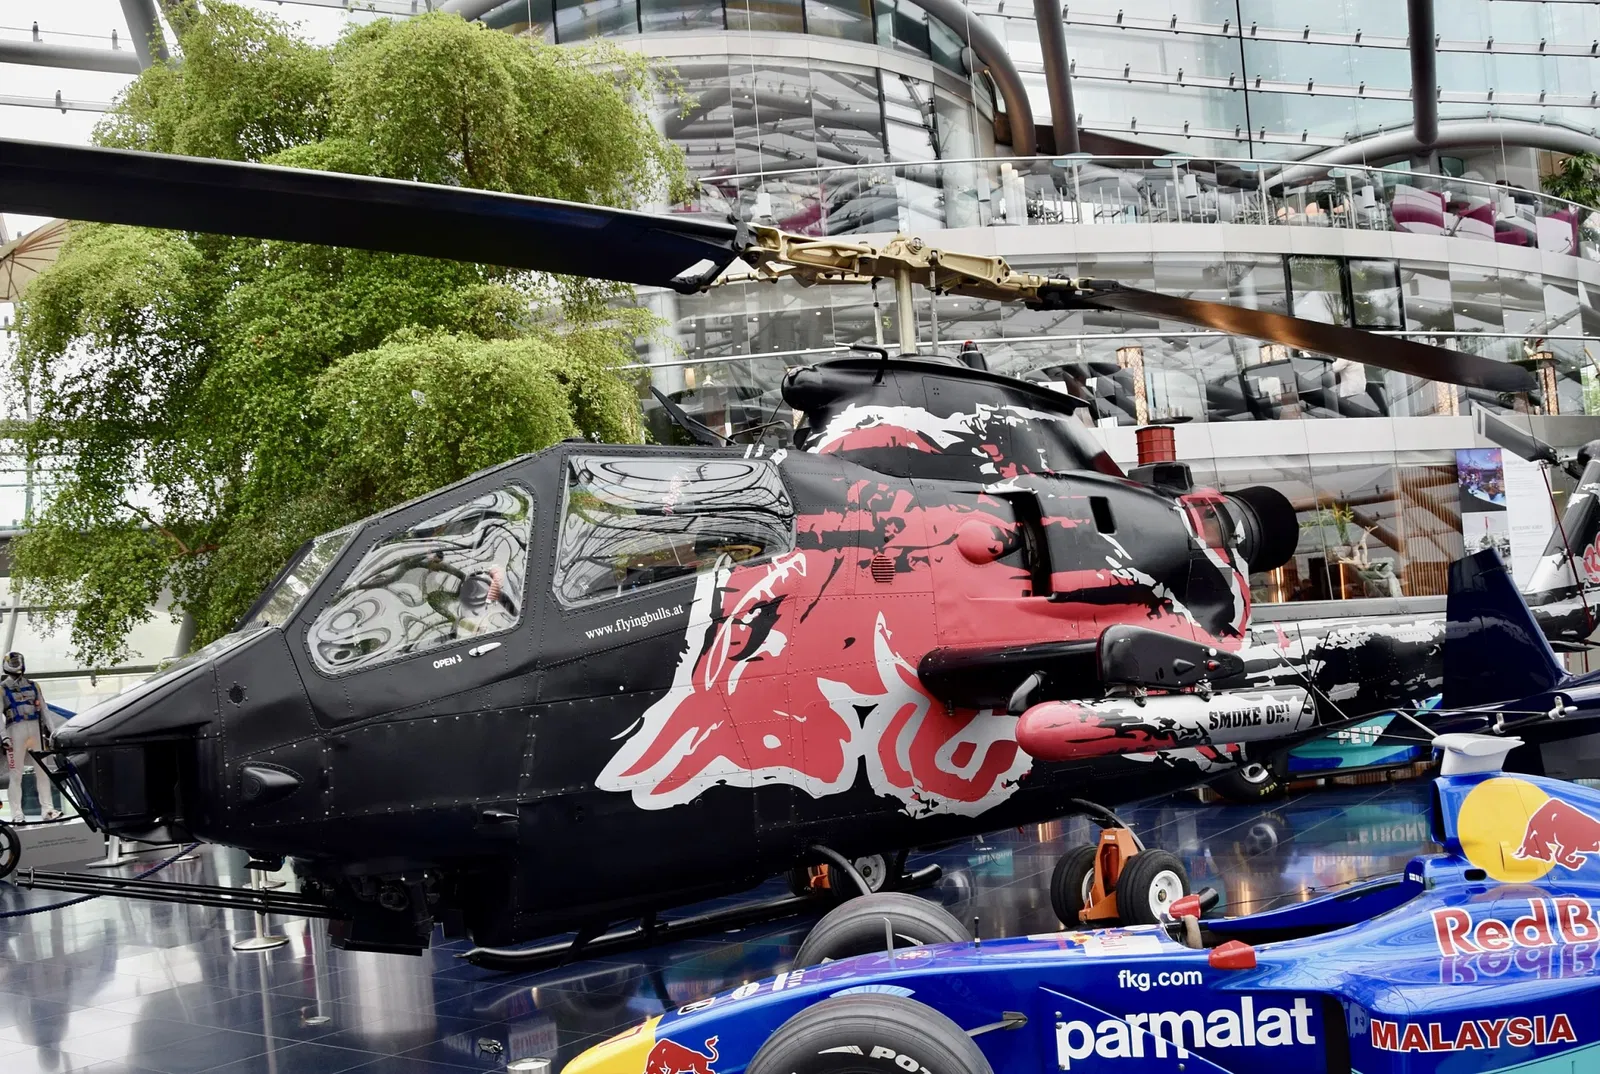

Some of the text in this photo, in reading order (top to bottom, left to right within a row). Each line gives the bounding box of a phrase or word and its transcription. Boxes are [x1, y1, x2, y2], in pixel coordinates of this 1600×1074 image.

[585, 603, 684, 640] www.flyingbulls.at
[433, 656, 456, 669] OPEN
[1208, 703, 1290, 730] SMOKE ON!
[1117, 969, 1203, 992] fkg.com
[1055, 996, 1316, 1071] parmalat
[1370, 1013, 1578, 1053] MALAYSIA
